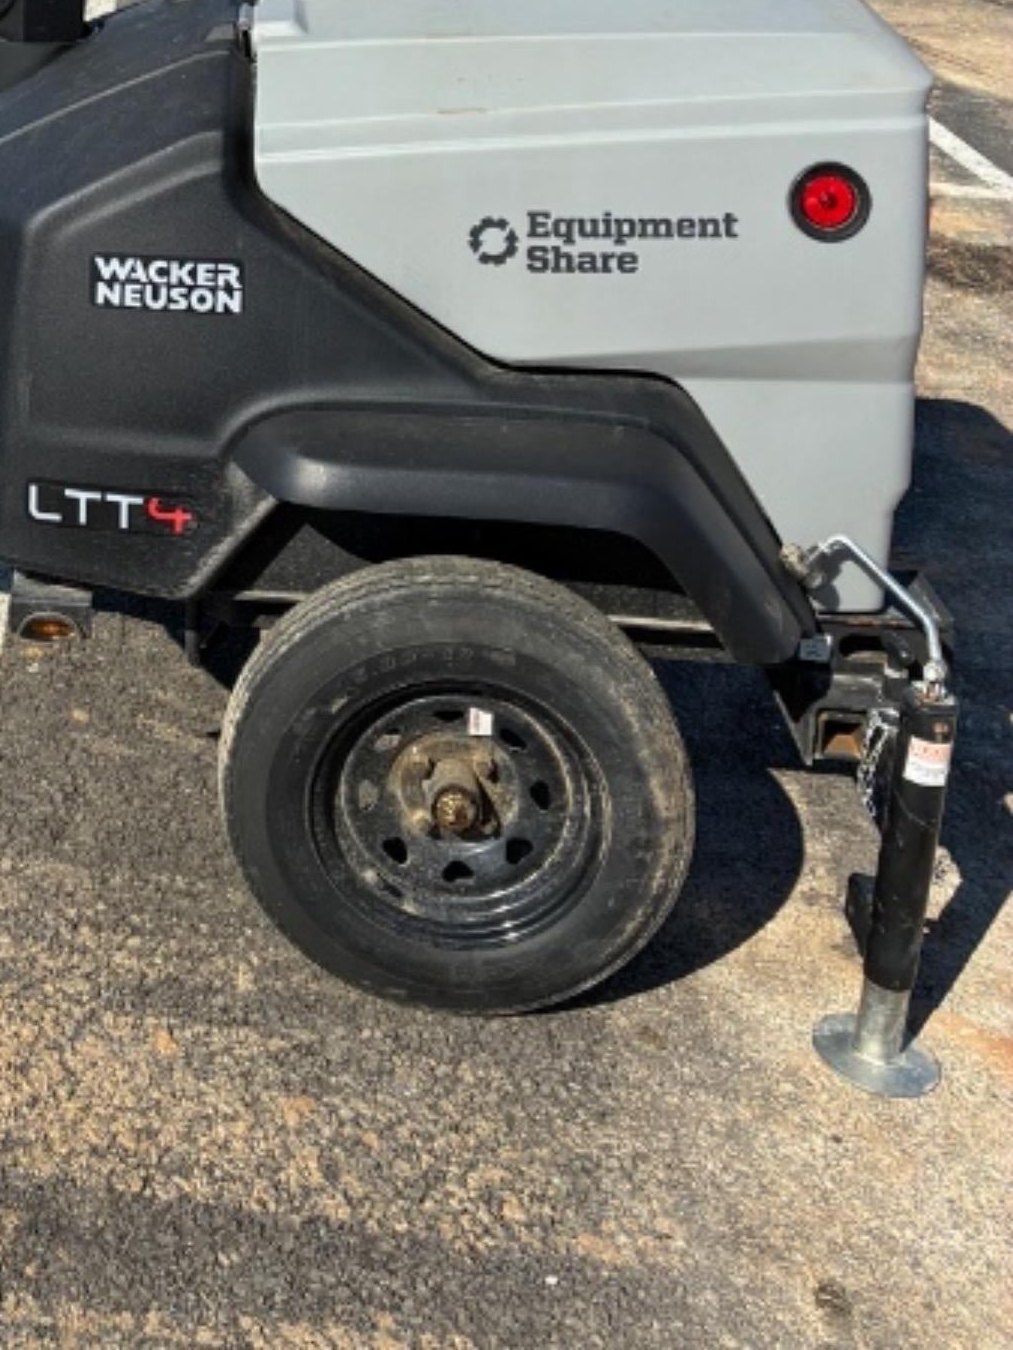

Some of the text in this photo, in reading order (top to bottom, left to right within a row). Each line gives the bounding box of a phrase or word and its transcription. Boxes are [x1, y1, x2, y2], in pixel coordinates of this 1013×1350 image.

[526, 211, 738, 244] Equipment
[94, 256, 243, 289] WACKER
[526, 245, 639, 273] Share
[95, 286, 243, 314] NEUSON
[28, 483, 194, 535] LTT4
